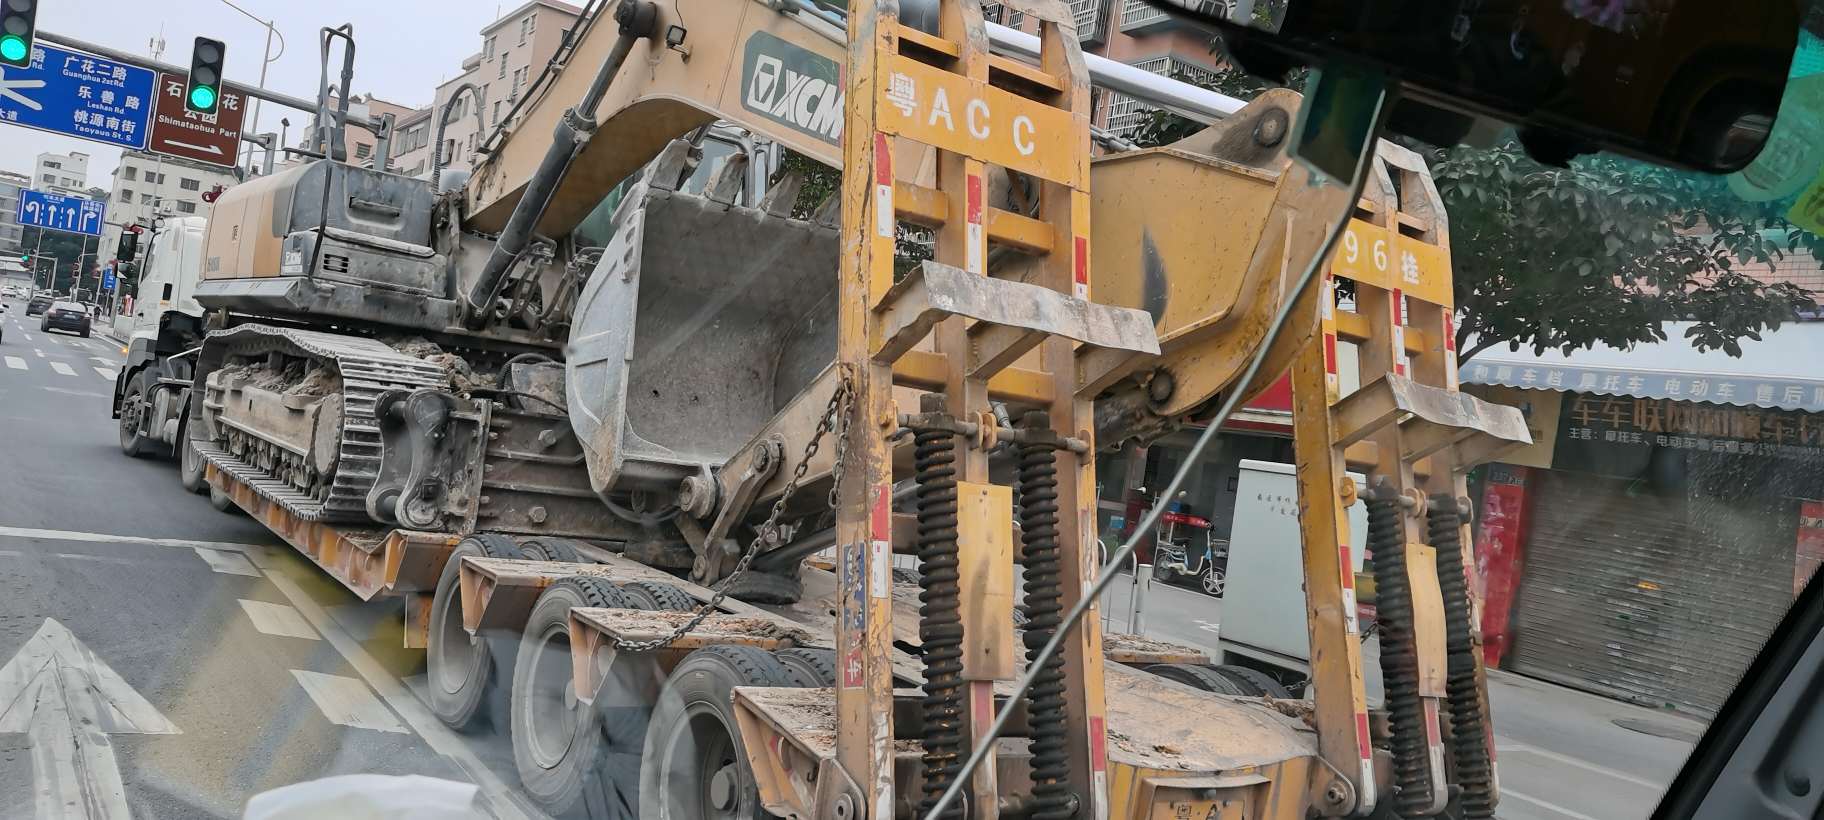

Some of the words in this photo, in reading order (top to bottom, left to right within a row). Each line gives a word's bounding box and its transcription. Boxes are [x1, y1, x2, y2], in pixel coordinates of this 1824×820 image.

[64, 56, 127, 81] 广花二路
[78, 85, 140, 111] 乐善路
[87, 101, 113, 113] Leshan
[74, 109, 137, 134] 桃源南街
[158, 114, 216, 134] Shimataohua
[1664, 378, 1737, 399] 电动车
